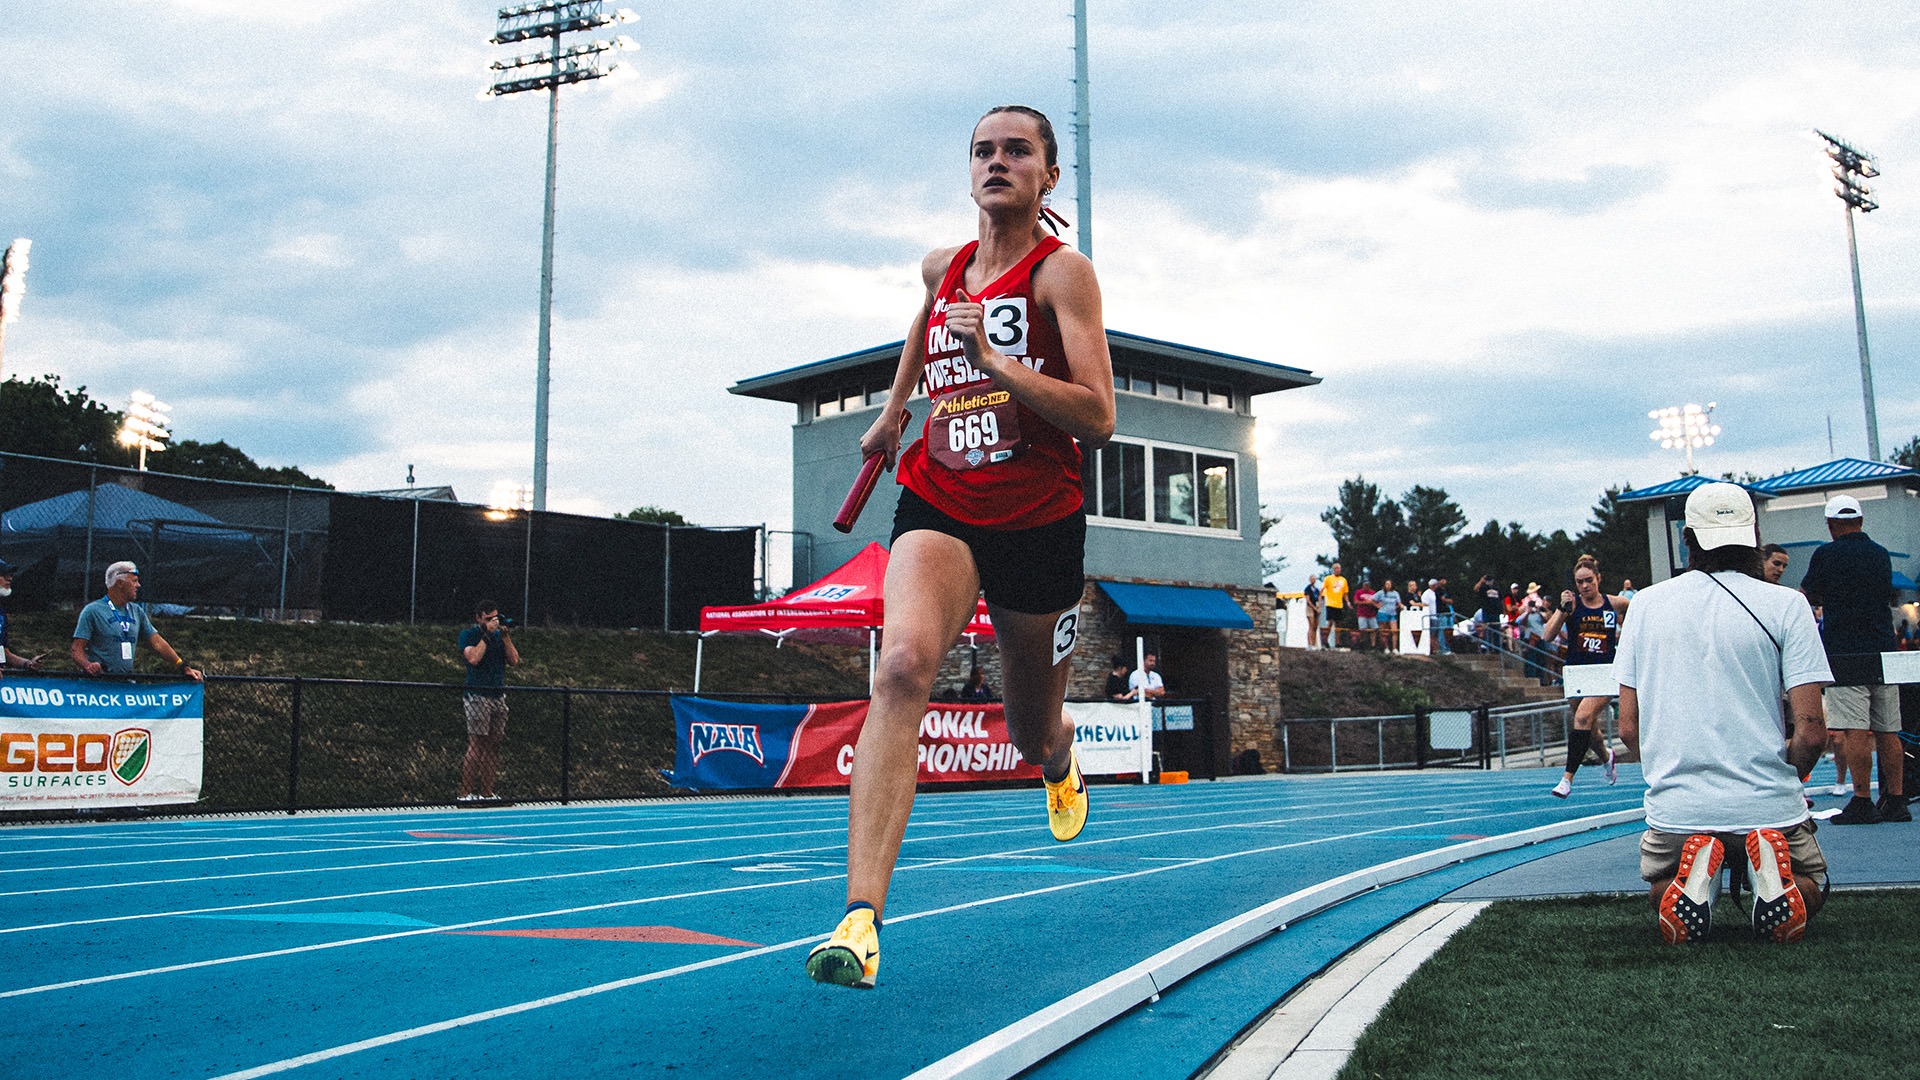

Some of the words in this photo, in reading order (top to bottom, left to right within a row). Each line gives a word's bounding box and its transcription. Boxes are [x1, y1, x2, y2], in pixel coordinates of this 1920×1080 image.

[989, 305, 1023, 346] 3
[924, 356, 1044, 391] WESLN
[932, 394, 988, 417] Athletic
[948, 411, 999, 452] 669
[1606, 613, 1613, 625] 2
[1056, 613, 1077, 653] 3
[1583, 637, 1601, 649] 702
[0, 686, 64, 706] ONDO
[66, 693, 122, 707] TRACK
[125, 693, 168, 706] BUILT
[172, 693, 192, 706] BY
[919, 711, 988, 738] IONAL
[1075, 725, 1139, 742] SHEVILL
[690, 722, 765, 767] NAIA
[837, 743, 1023, 775] CPIONSHIP
[8, 774, 107, 788] SURFACES
